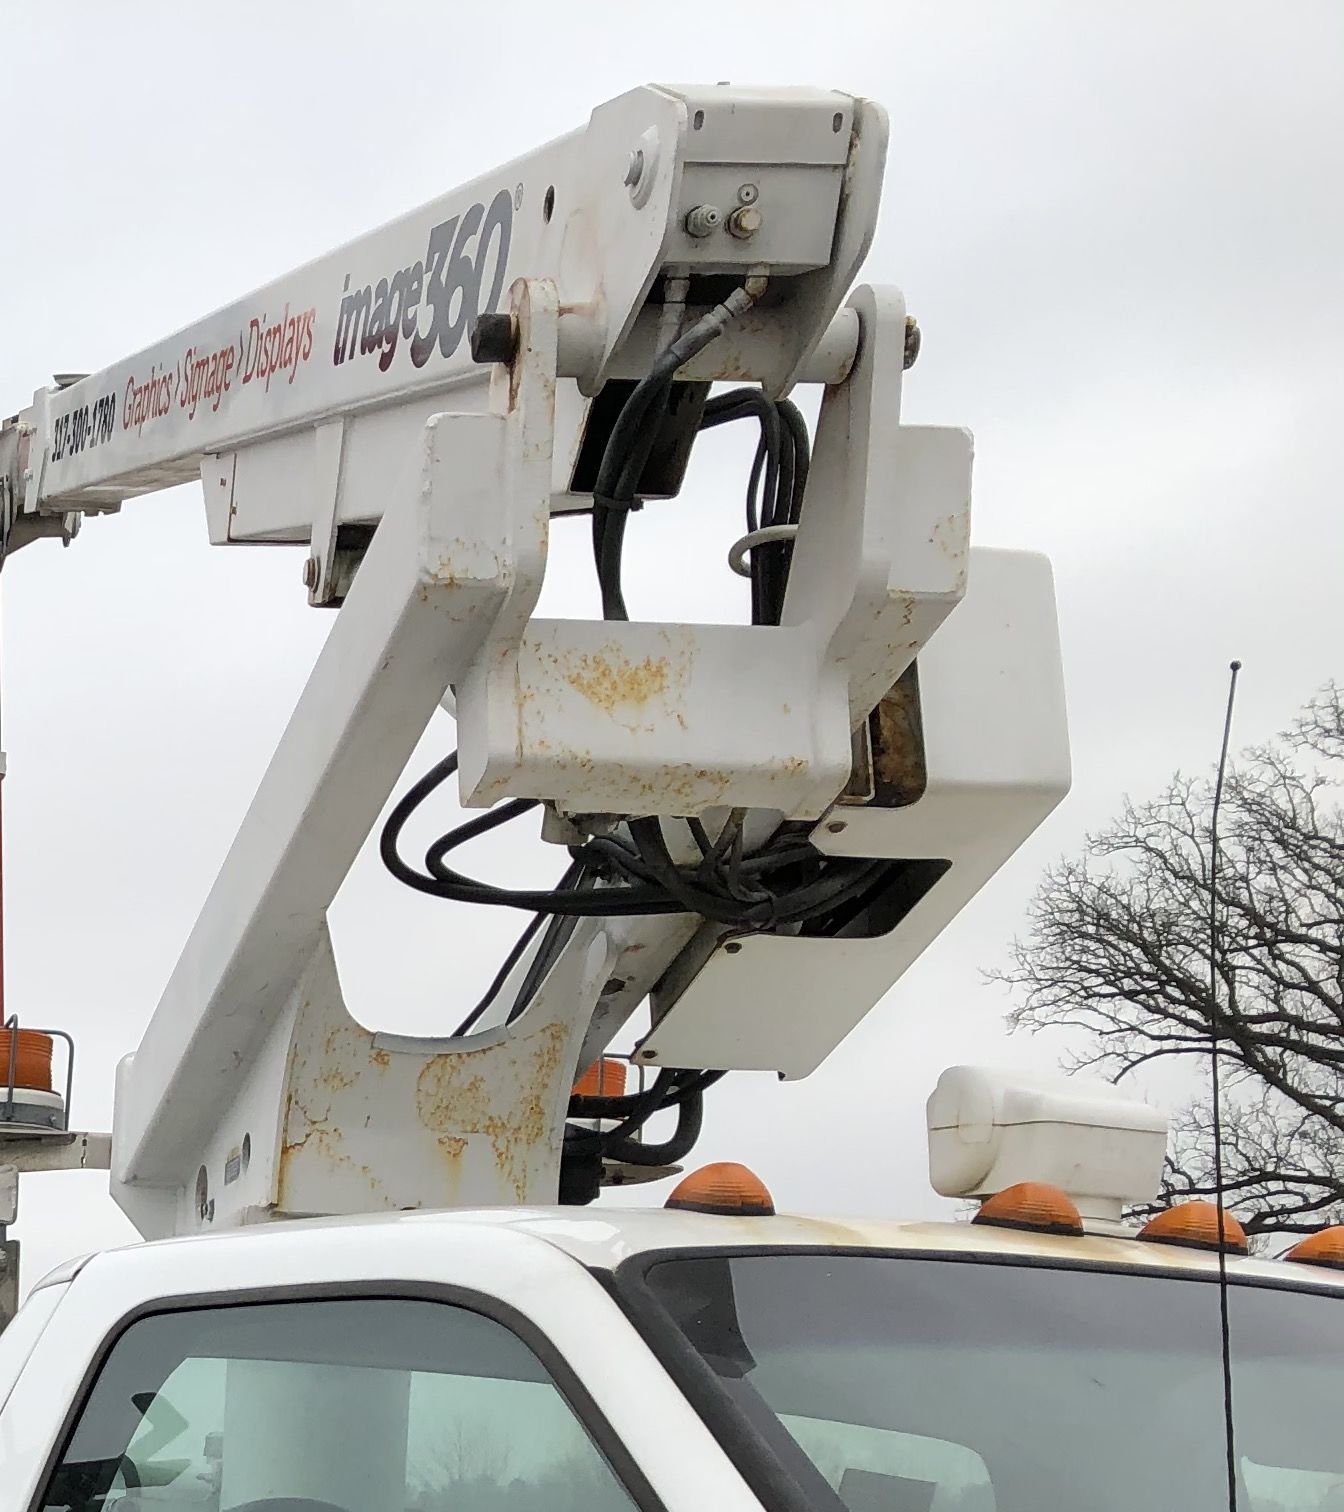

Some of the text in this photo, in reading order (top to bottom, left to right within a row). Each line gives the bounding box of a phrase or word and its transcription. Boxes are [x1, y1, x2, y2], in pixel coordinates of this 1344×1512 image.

[122, 362, 173, 438] Graphics
[180, 345, 235, 421] Signage
[242, 302, 316, 394] Displays
